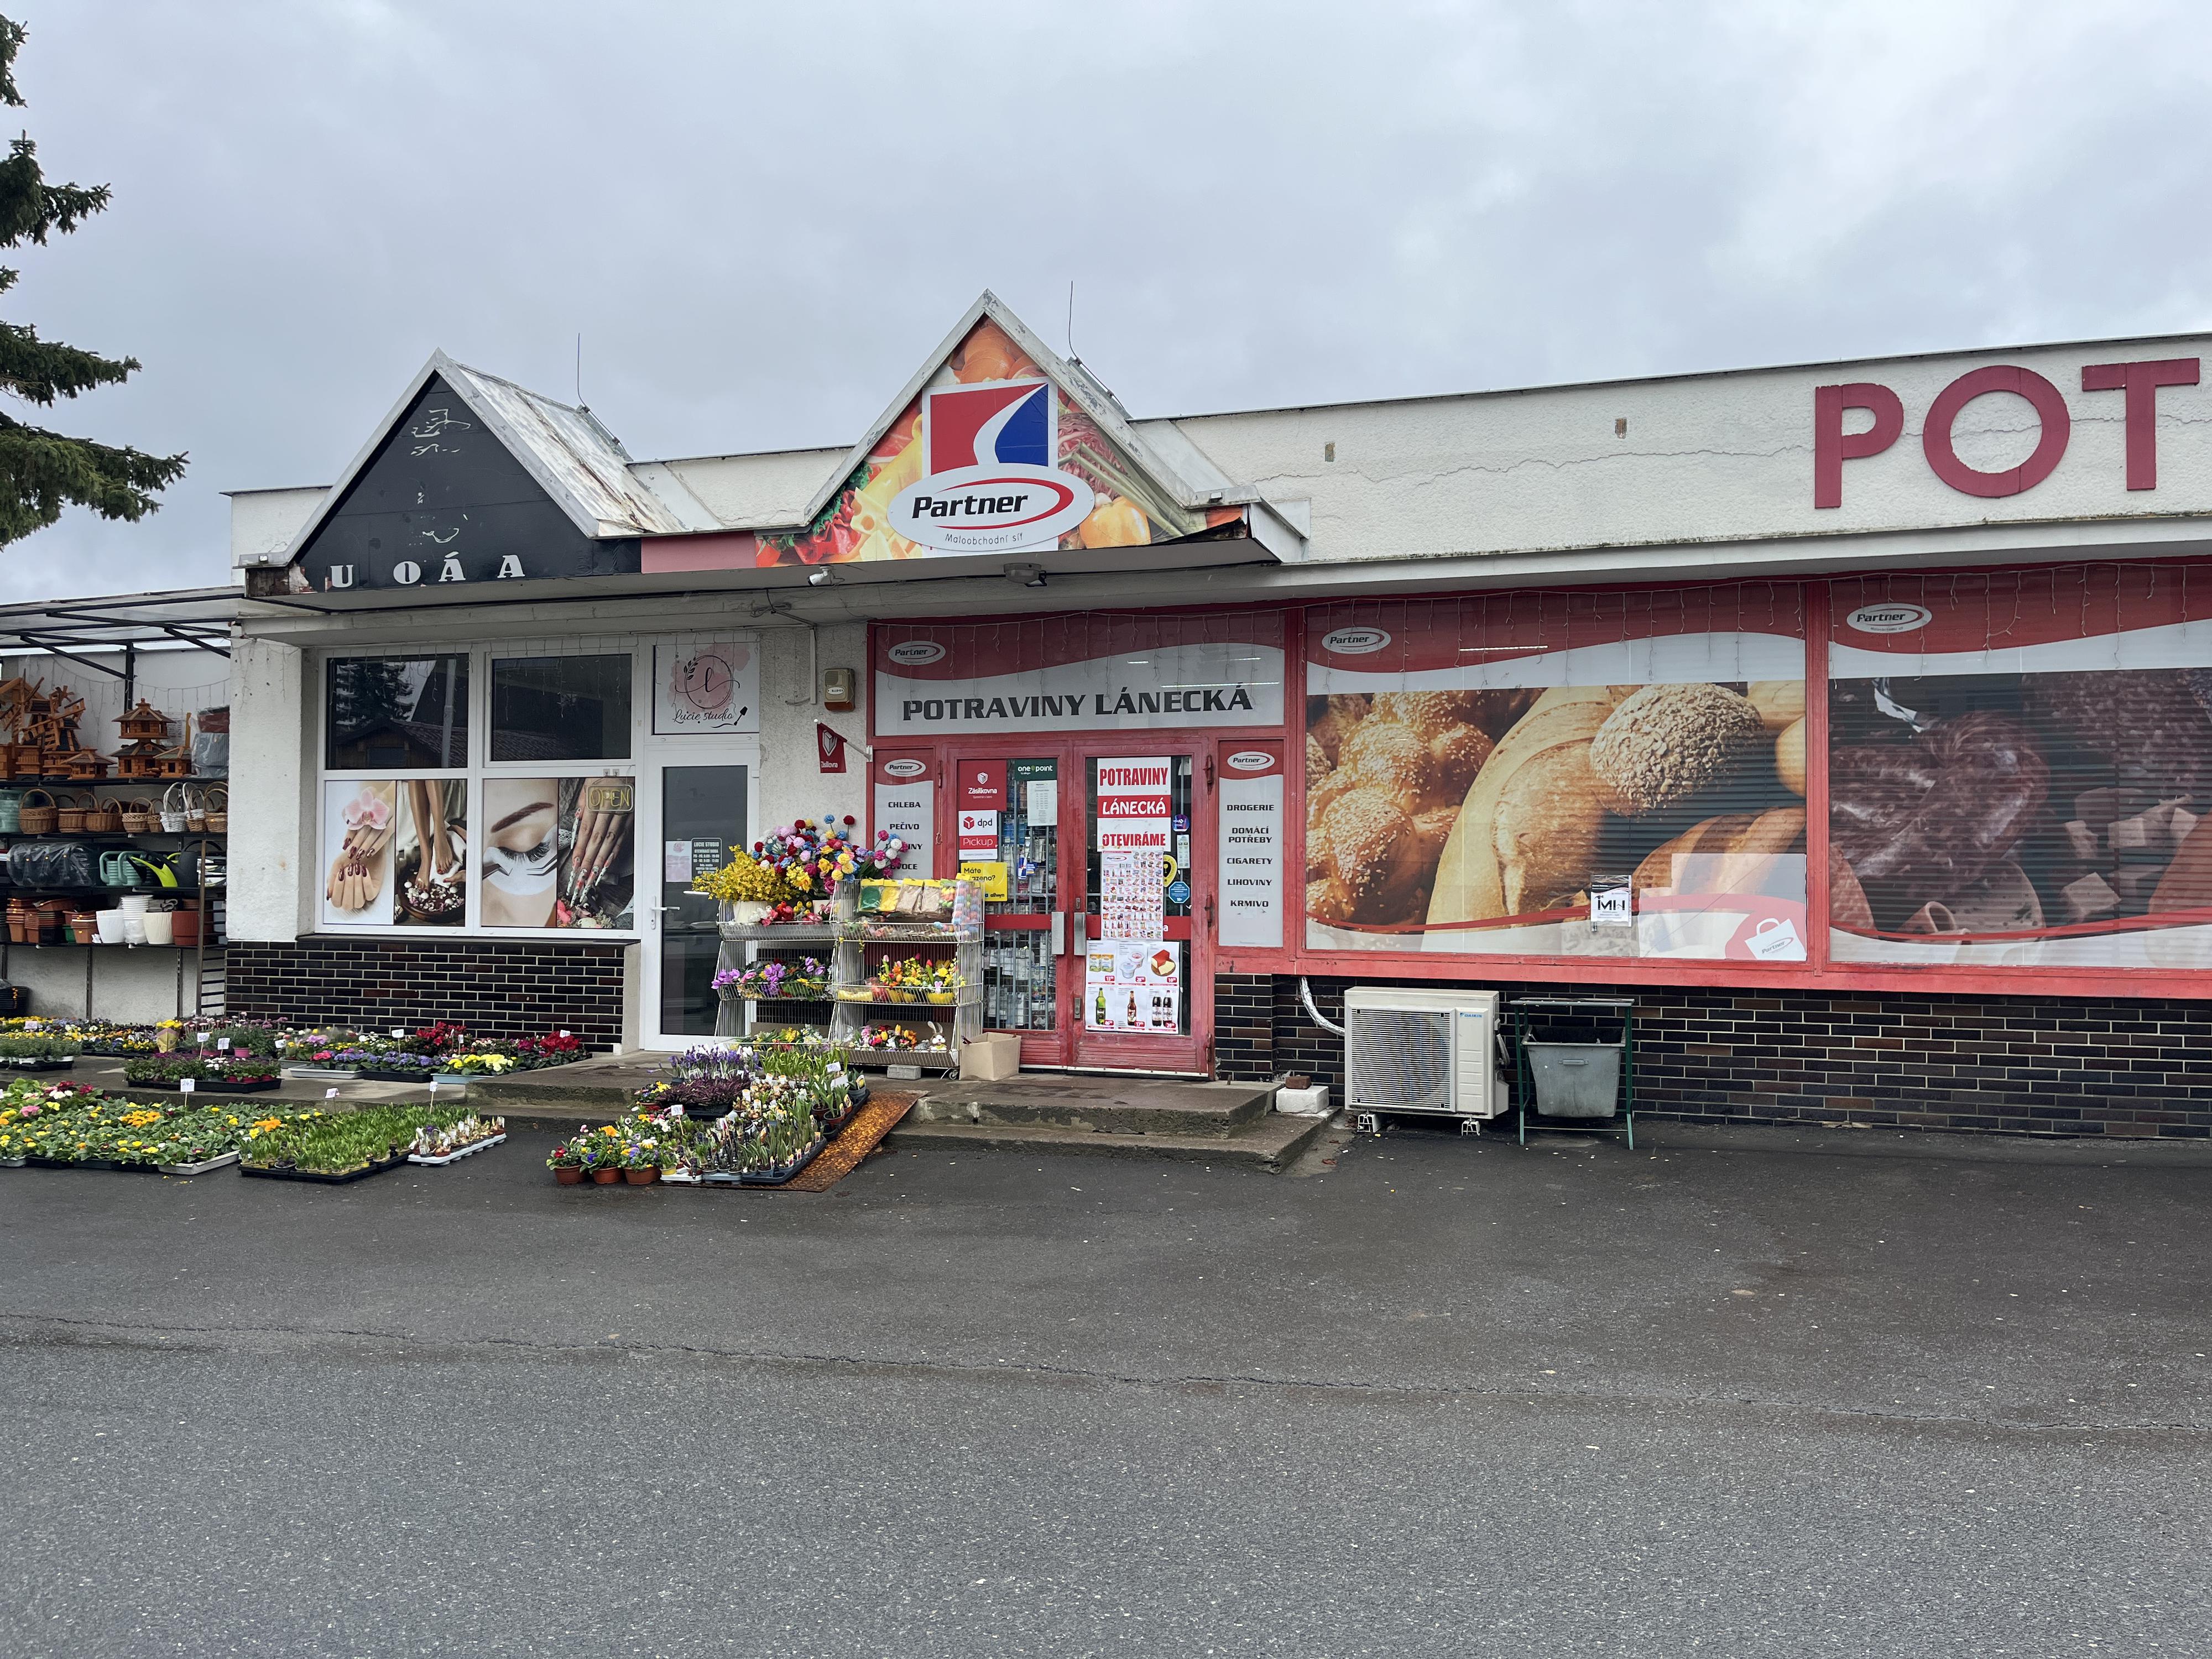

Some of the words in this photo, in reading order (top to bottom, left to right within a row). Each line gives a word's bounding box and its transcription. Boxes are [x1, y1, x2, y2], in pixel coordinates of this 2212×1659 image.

[1815, 357, 2200, 509] POT
[912, 494, 1029, 519] Partner
[945, 533, 1008, 545] Maloobchodní
[1012, 532, 1022, 542] síť
[1856, 613, 1906, 623] Partner
[1329, 636, 1370, 644] Partner
[903, 693, 1086, 721] POTRAVINY
[1095, 682, 1253, 716] LÁNECKÁ
[672, 708, 701, 724] Lucie
[1099, 767, 1168, 786] POTRAVINY
[589, 788, 630, 807] OPEN
[1102, 797, 1166, 815] LÁNECKÁ
[889, 822, 920, 830] PEČIVO
[977, 818, 993, 828] dpd
[963, 837, 993, 847] Pickup
[1102, 831, 1166, 846] OTEVIRÁME
[1228, 834, 1272, 843] POTŘEBY
[1761, 941, 1786, 954] Partner
